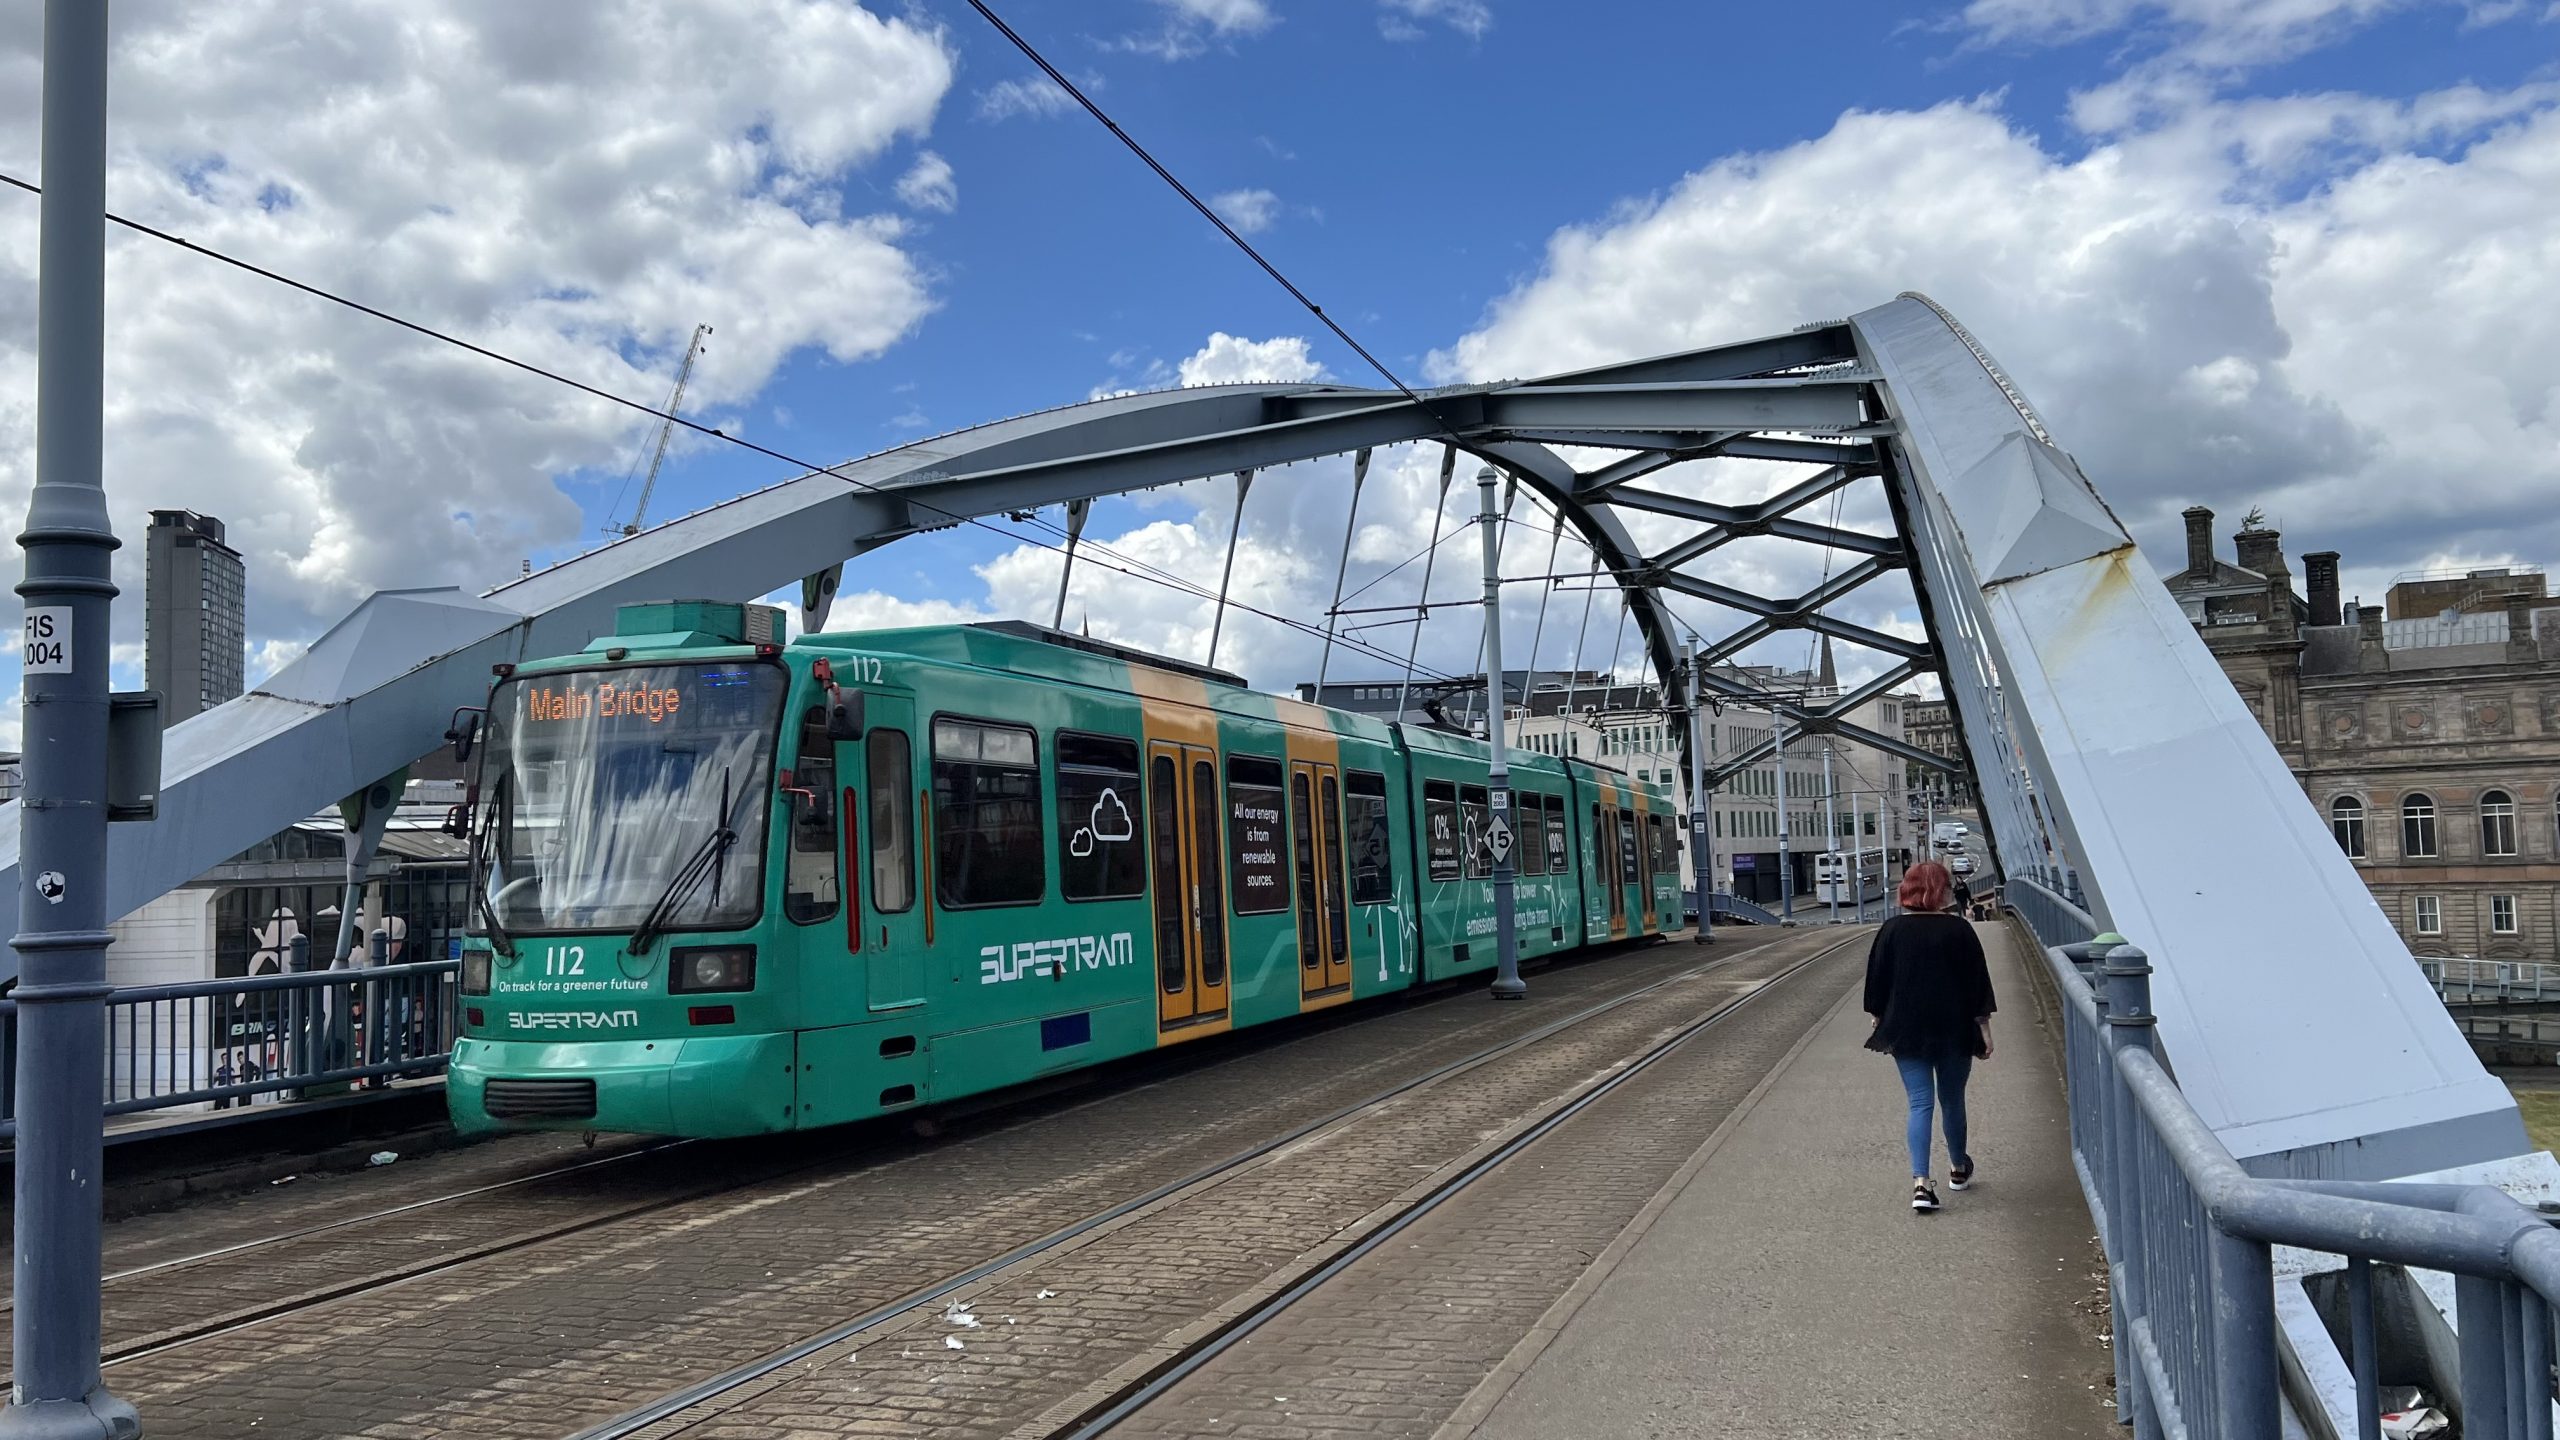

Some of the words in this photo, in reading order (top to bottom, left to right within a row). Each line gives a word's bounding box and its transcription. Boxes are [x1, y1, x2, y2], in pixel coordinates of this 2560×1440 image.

[24, 641, 63, 666] 004
[852, 655, 884, 684] 112
[530, 687, 592, 721] Malin
[599, 681, 680, 723] Bridge
[1234, 803, 1244, 819] All
[1244, 807, 1256, 819] our
[1256, 808, 1279, 824] energy
[1246, 826, 1253, 842] is
[1253, 826, 1270, 842] from
[1434, 814, 1450, 840] 0%
[1487, 831, 1509, 849] 15
[1242, 849, 1276, 865] renewable
[1246, 875, 1274, 887] sources.
[546, 946, 585, 976] 112
[980, 932, 1133, 985] SUPERTRAM
[499, 981, 511, 993] On
[512, 980, 535, 992] track
[538, 980, 552, 992] for
[553, 982, 560, 991] a
[563, 981, 607, 994] greener
[610, 979, 648, 991] future
[508, 1010, 638, 1029] SUPERTRAM
